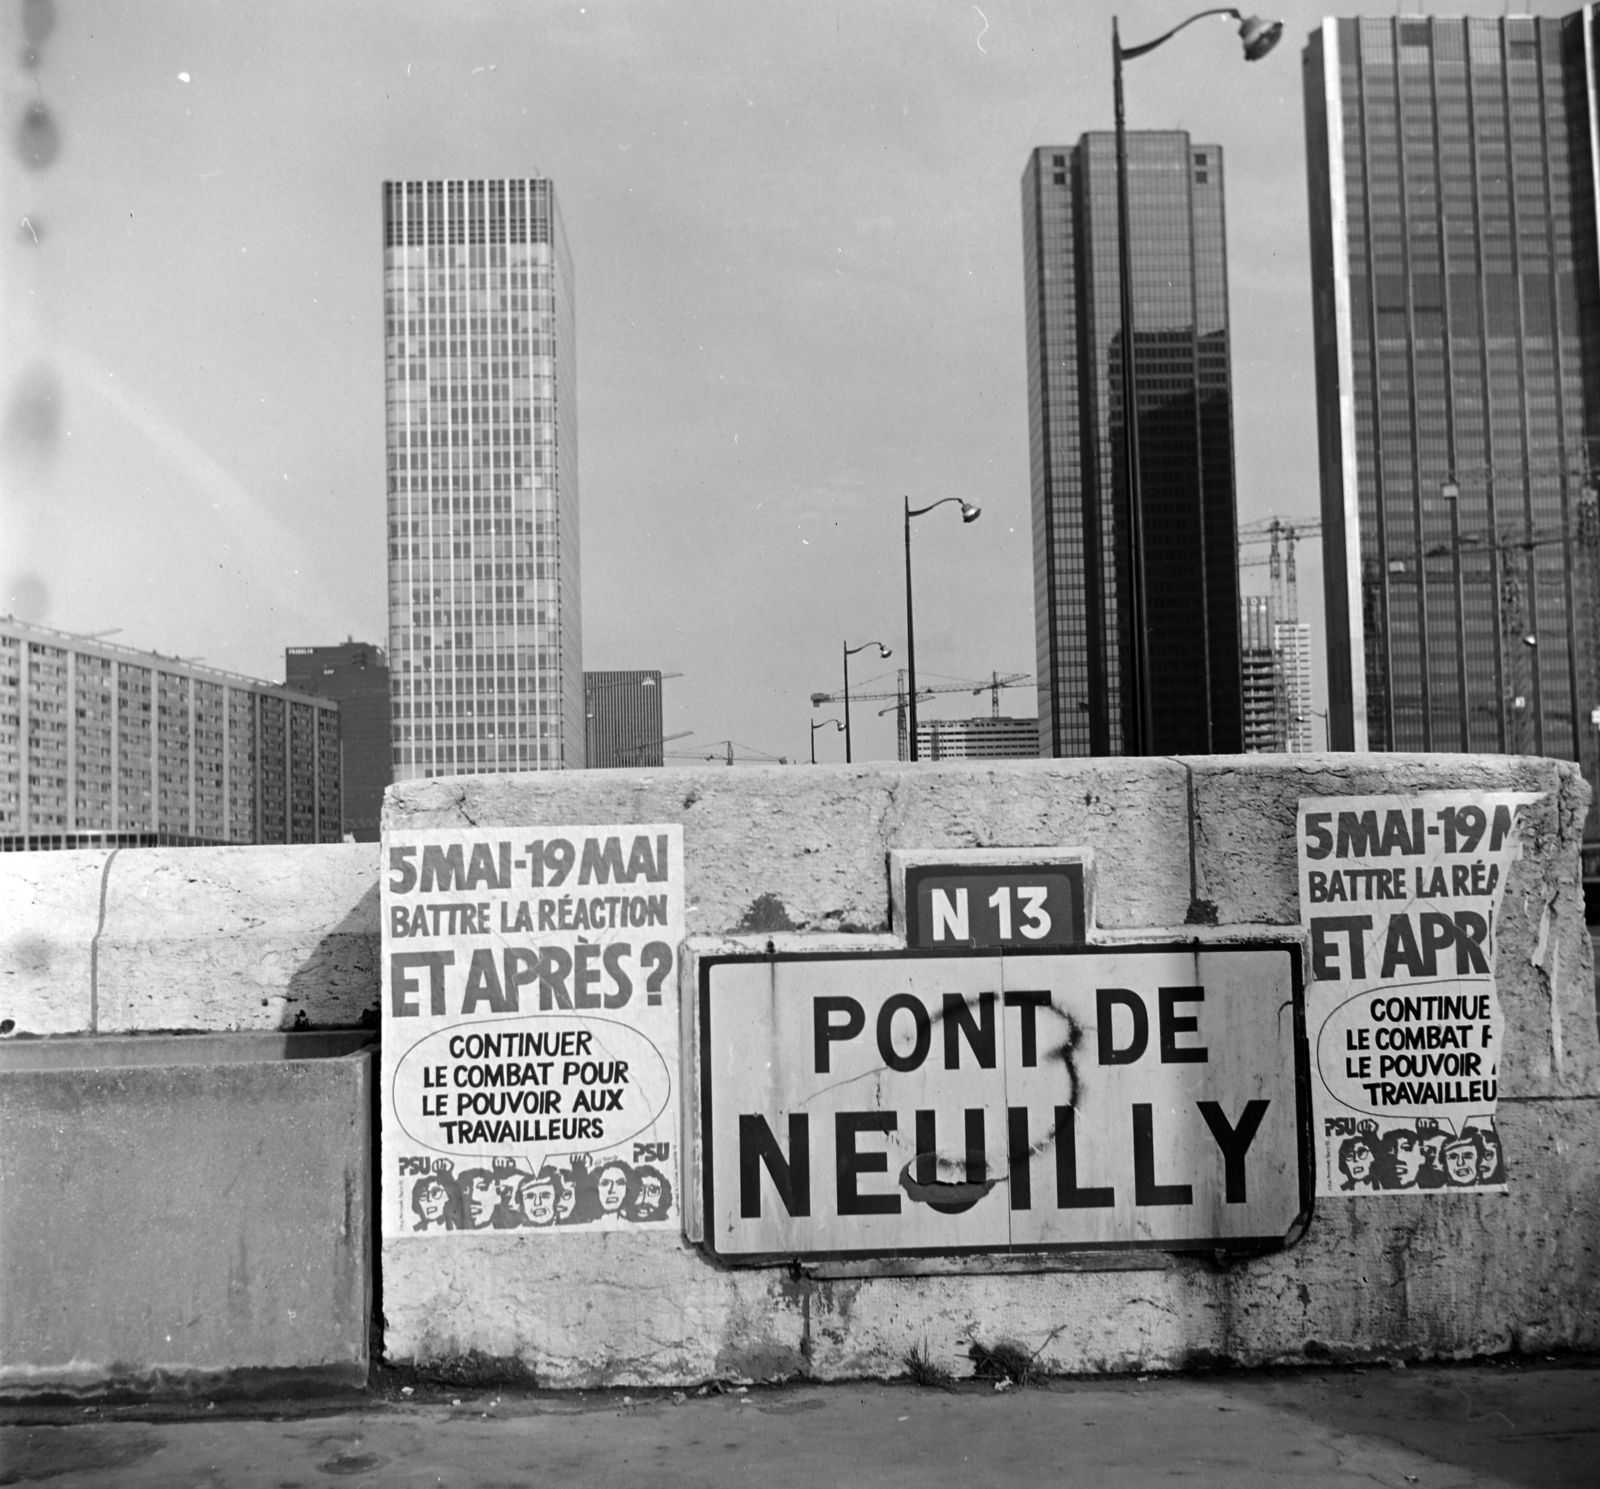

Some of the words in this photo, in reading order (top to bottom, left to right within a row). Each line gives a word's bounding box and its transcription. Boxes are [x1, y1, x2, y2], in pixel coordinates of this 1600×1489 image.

[1308, 867, 1407, 903] BATTRE
[391, 902, 491, 939] BATTRE
[931, 887, 970, 941] N
[988, 886, 1052, 940] 13
[1310, 914, 1373, 981] ET
[391, 950, 455, 1018] ET
[1370, 995, 1491, 1022] CONTINUE
[813, 989, 1052, 1074] PONT
[1096, 986, 1209, 1066] DE
[1346, 1029, 1370, 1051] LE
[1375, 1025, 1474, 1051] COMBAT
[449, 1031, 593, 1059] CONTINUER
[423, 1065, 448, 1088] LE
[453, 1062, 555, 1088] COMBAT
[563, 1061, 630, 1086] POUR
[1346, 1056, 1371, 1079] LE
[1380, 1052, 1482, 1078] POUVOIR
[422, 1093, 448, 1116] LE
[457, 1089, 562, 1116] POUVOIR
[572, 1089, 624, 1113] AUX
[1363, 1079, 1497, 1106] TRAVAILLEU
[439, 1118, 604, 1145] TRAVAILLEURS
[1324, 1117, 1356, 1137] PSU
[399, 1156, 431, 1176] PSU
[633, 1142, 670, 1163] PSU
[738, 1099, 1271, 1219] NEUILLY
